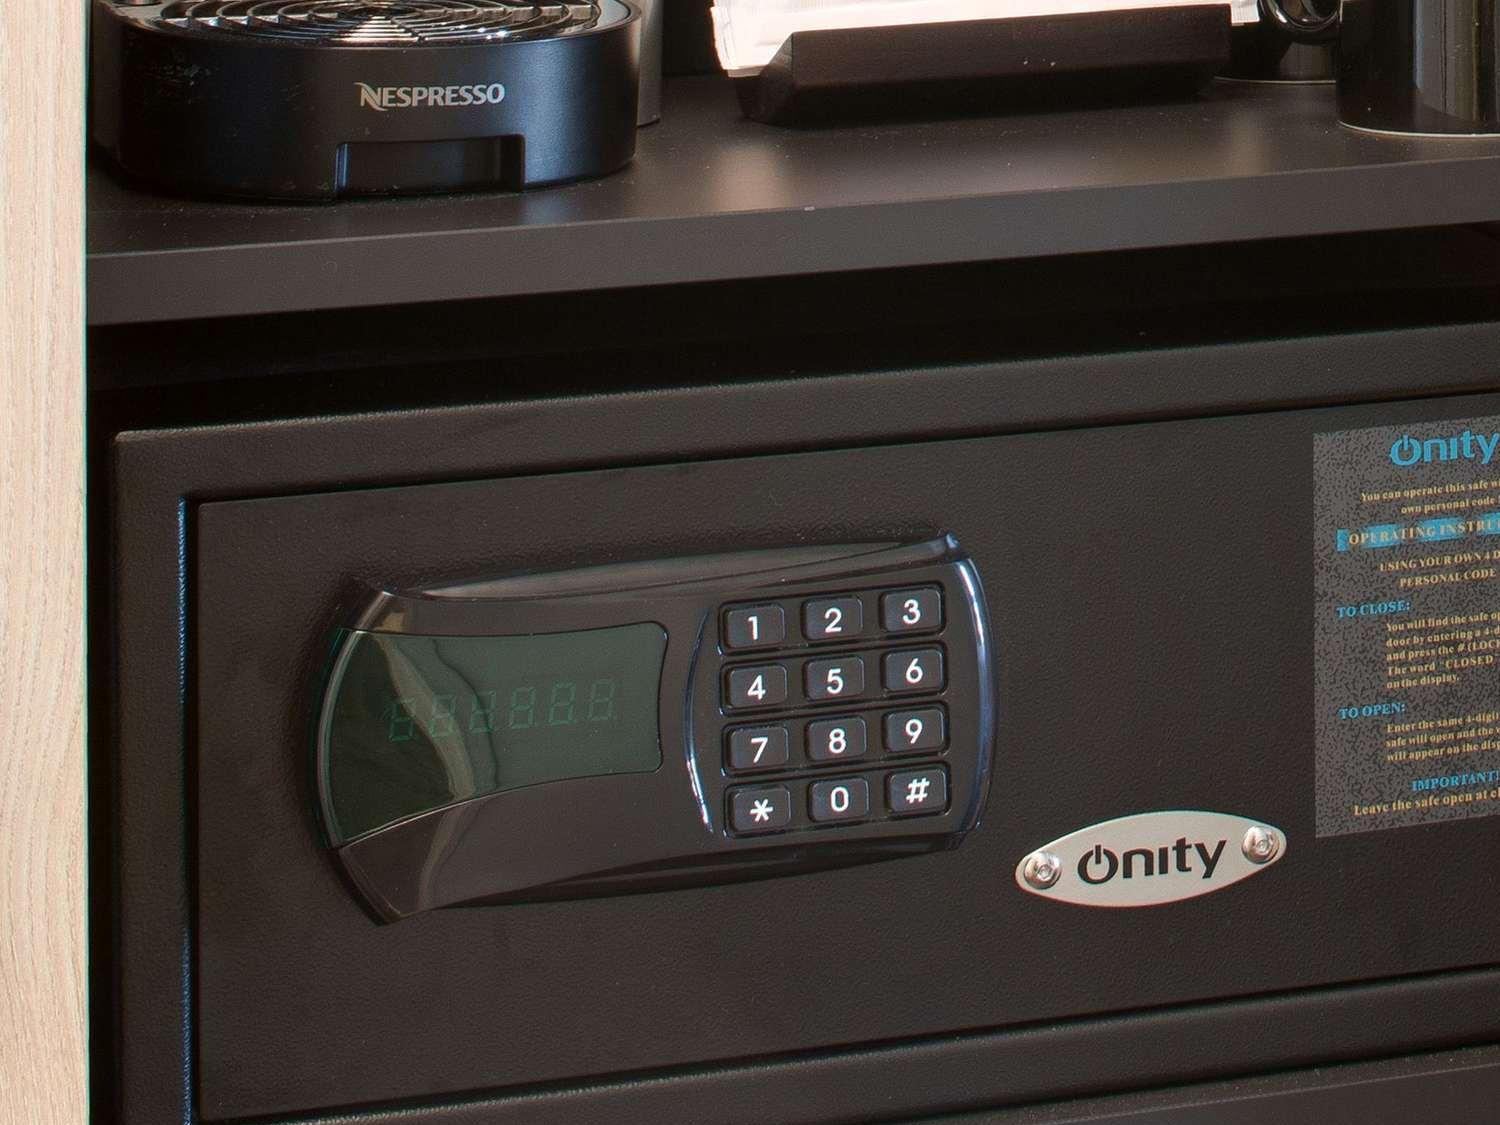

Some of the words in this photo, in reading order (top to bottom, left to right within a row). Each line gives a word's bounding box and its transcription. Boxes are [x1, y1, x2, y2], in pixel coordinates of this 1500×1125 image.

[354, 82, 505, 111] NESPRESSO
[1391, 430, 1500, 465] Onity
[1360, 492, 1380, 503] You
[1383, 491, 1401, 500] can
[1403, 487, 1443, 499] operate
[1445, 483, 1466, 493] this
[1469, 480, 1489, 490] safe
[1401, 505, 1421, 514] own
[1424, 499, 1470, 513] personal
[1472, 495, 1495, 505] code
[1349, 525, 1436, 545] OPERATING
[1379, 559, 1418, 572] USING
[1418, 555, 1452, 567] YOUR
[1454, 552, 1483, 563] OWN
[1400, 571, 1463, 588] PERSONAL
[1465, 568, 1497, 580] CODE
[1337, 605, 1357, 618] TO
[1360, 600, 1411, 616] CLOSE:
[748, 615, 759, 640] 1
[824, 607, 843, 633] 2
[902, 599, 921, 624] 3
[1386, 622, 1405, 632] You
[1407, 619, 1425, 629] will
[1427, 616, 1448, 627] find
[1450, 614, 1467, 624] the
[1468, 611, 1488, 622] safe
[1386, 637, 1410, 648] door
[1413, 636, 1425, 646] by
[1427, 630, 1473, 643] entering
[1386, 650, 1405, 661] and
[1408, 648, 1436, 661] press
[1438, 644, 1454, 654] the
[747, 674, 766, 700] 4
[826, 668, 844, 694] 5
[905, 658, 924, 683] 6
[1387, 666, 1407, 677] The
[1409, 662, 1436, 672] word
[1386, 680, 1400, 689] on
[1401, 676, 1418, 687] the
[1420, 672, 1460, 687] display.
[1338, 706, 1359, 720] TO
[1361, 702, 1406, 717] OPEN:
[1386, 723, 1416, 733] Enter
[1418, 719, 1434, 730] the
[1437, 718, 1463, 727] same
[750, 736, 769, 764] 7
[828, 728, 847, 754] 8
[905, 718, 923, 744] 9
[1385, 737, 1407, 748] safe
[1409, 735, 1427, 746] will
[1429, 732, 1455, 744] open
[1457, 727, 1475, 738] and
[1477, 726, 1493, 736] the
[1387, 751, 1406, 761] will
[1408, 747, 1444, 761] appear
[1447, 745, 1460, 755] on
[1462, 741, 1479, 751] the
[1411, 769, 1500, 792] IMPORTANT!
[830, 786, 849, 812] 0
[906, 777, 930, 803] #
[1354, 803, 1390, 816] Leave
[1392, 799, 1412, 811] the
[1414, 795, 1440, 807] safe
[1442, 792, 1473, 806] open
[1475, 789, 1488, 800] at
[1077, 837, 1227, 885] Onity
